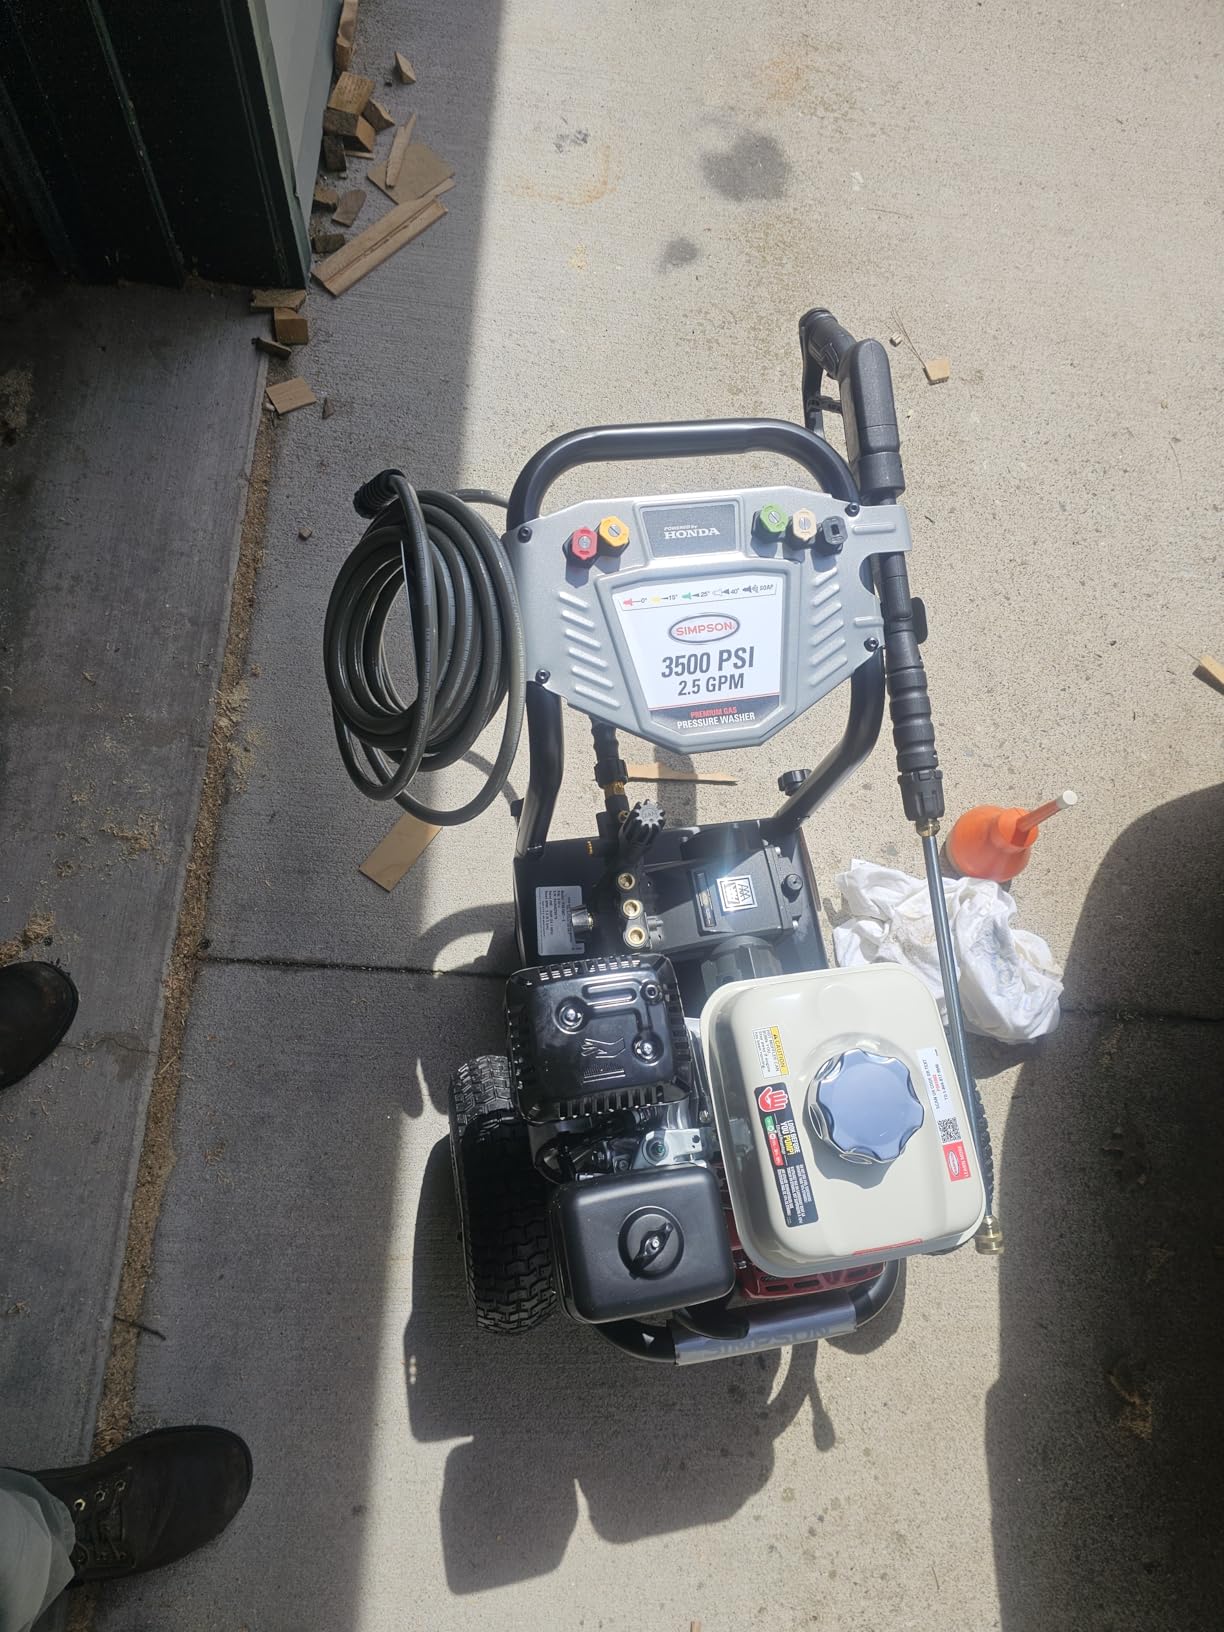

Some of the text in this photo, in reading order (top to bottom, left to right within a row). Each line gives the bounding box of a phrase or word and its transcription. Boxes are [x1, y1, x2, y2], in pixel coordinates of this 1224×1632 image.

[664, 527, 720, 540] HONDA
[676, 621, 732, 636] SIMPSON
[661, 646, 755, 678] 3500 PSI
[678, 672, 744, 697] 2.5 GPM
[676, 712, 756, 729] PRESSURE WASHER
[690, 706, 738, 719] PREMIUM GAS
[775, 1040, 784, 1067] CAUTION
[780, 1121, 795, 1155] YOU PUMP!
[787, 1120, 800, 1153] LOOK BEFORE
